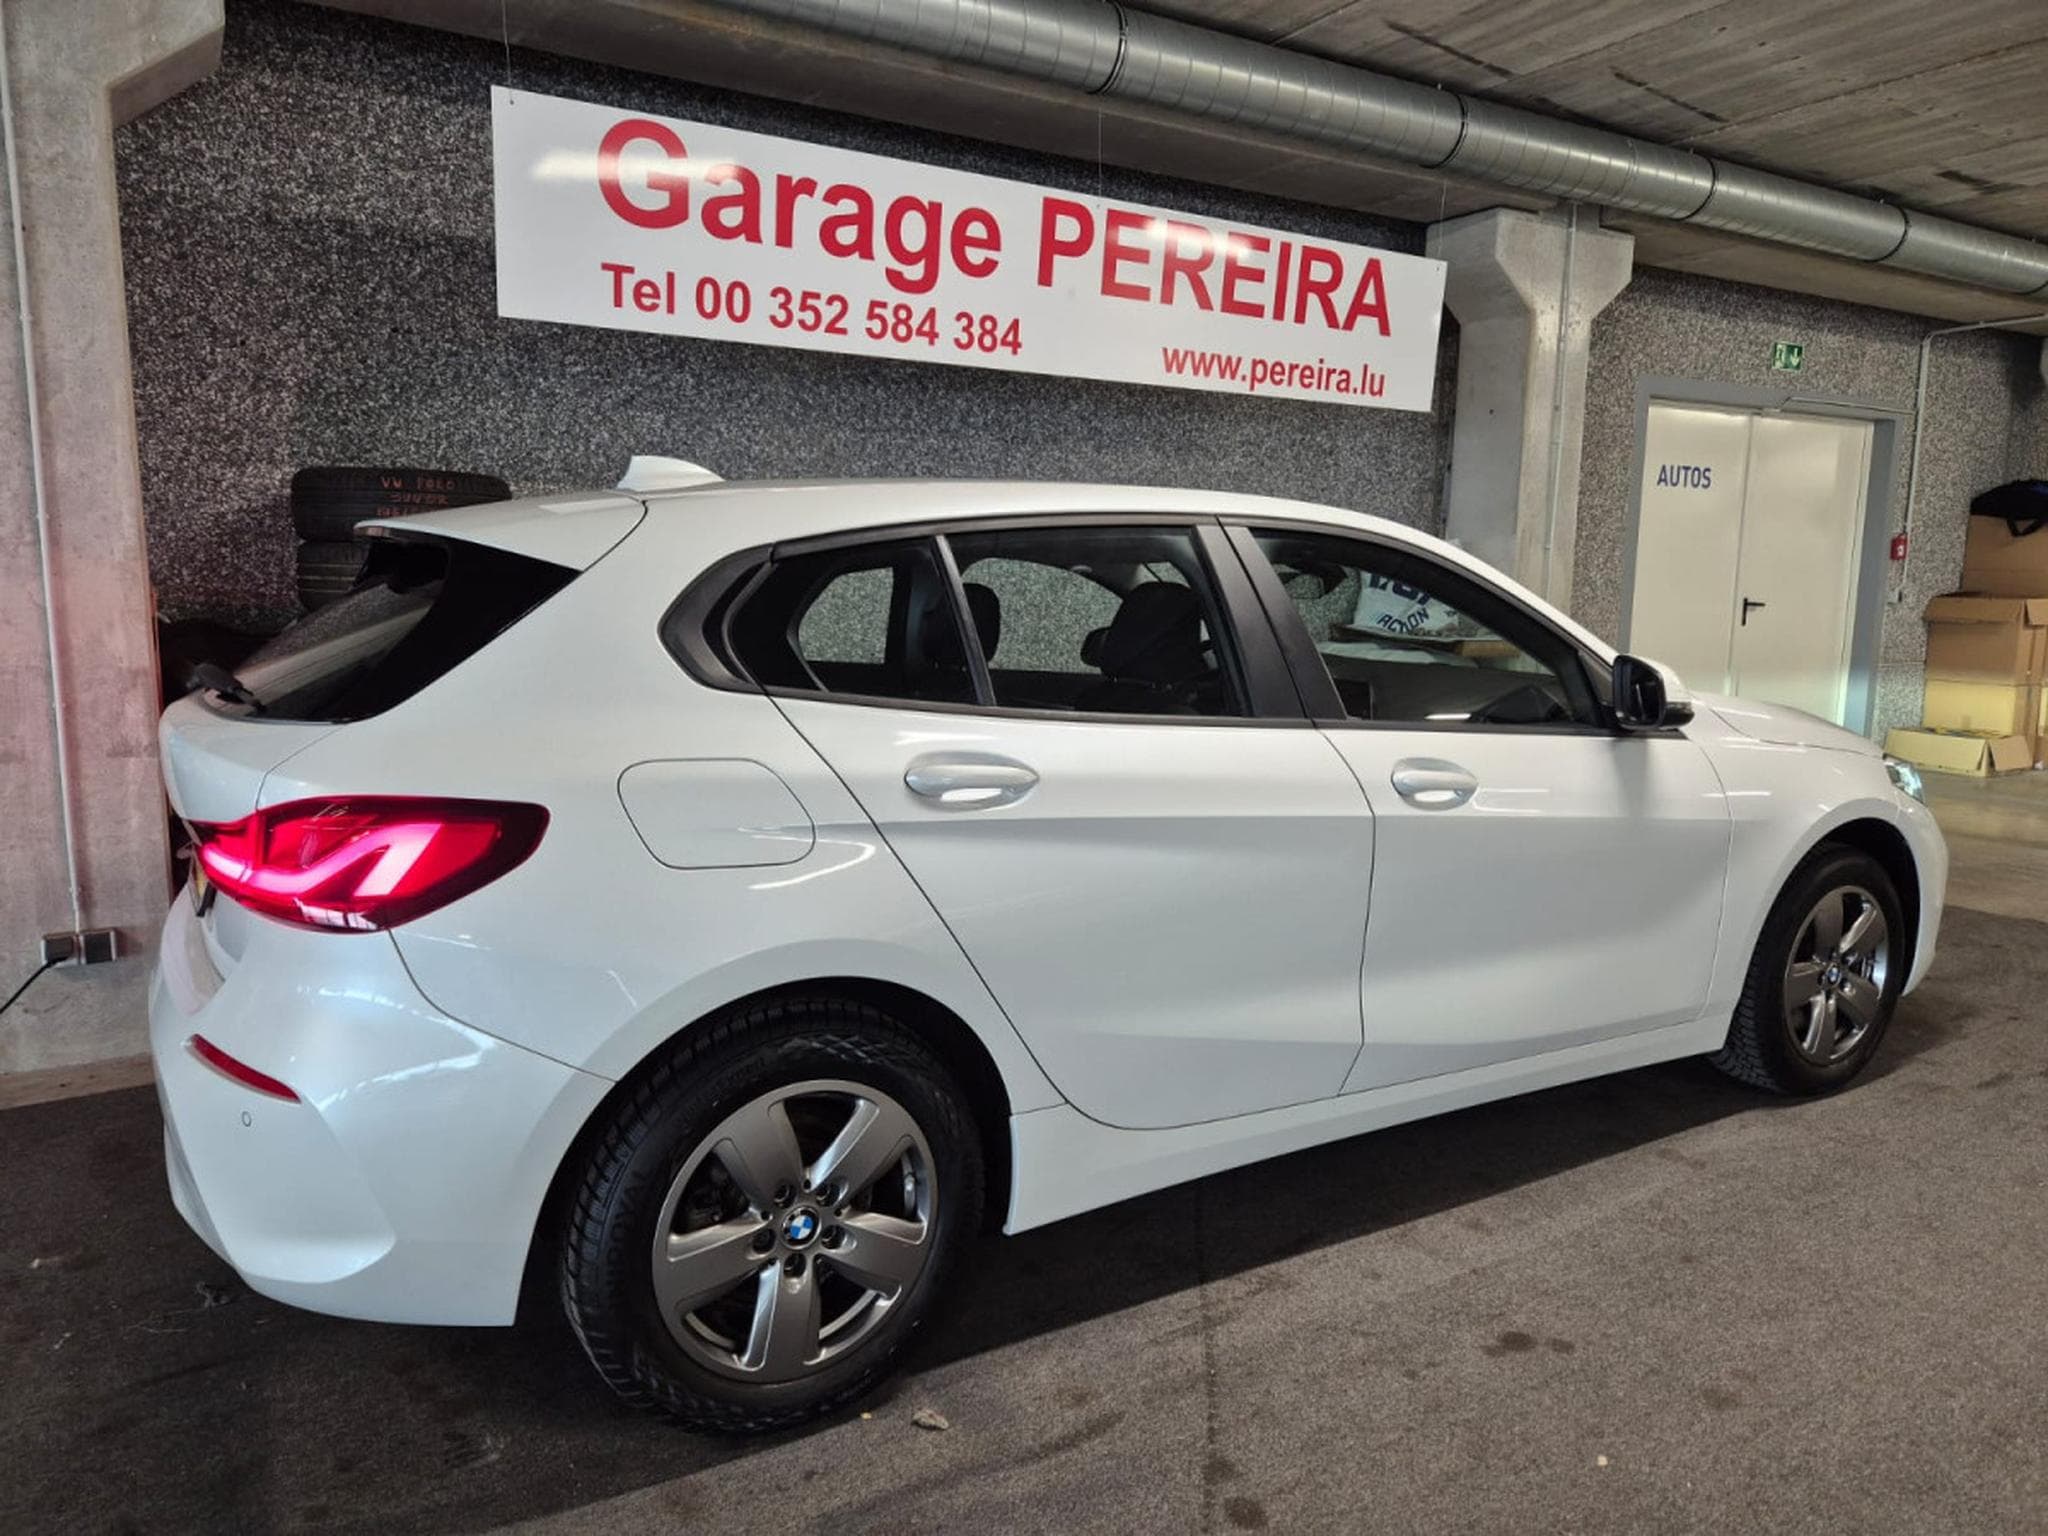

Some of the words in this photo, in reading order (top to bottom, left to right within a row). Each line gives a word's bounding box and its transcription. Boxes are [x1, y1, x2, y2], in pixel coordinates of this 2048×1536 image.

[597, 117, 1004, 297] Garage
[1036, 195, 1393, 338] PEREIRA
[600, 261, 677, 317] Tel
[694, 275, 753, 325] 00
[767, 285, 850, 337] 352
[864, 298, 941, 349] 584
[952, 310, 1024, 357] 384
[1161, 346, 1386, 399] www.pereira.lu
[1656, 464, 1712, 490] AUTOS
